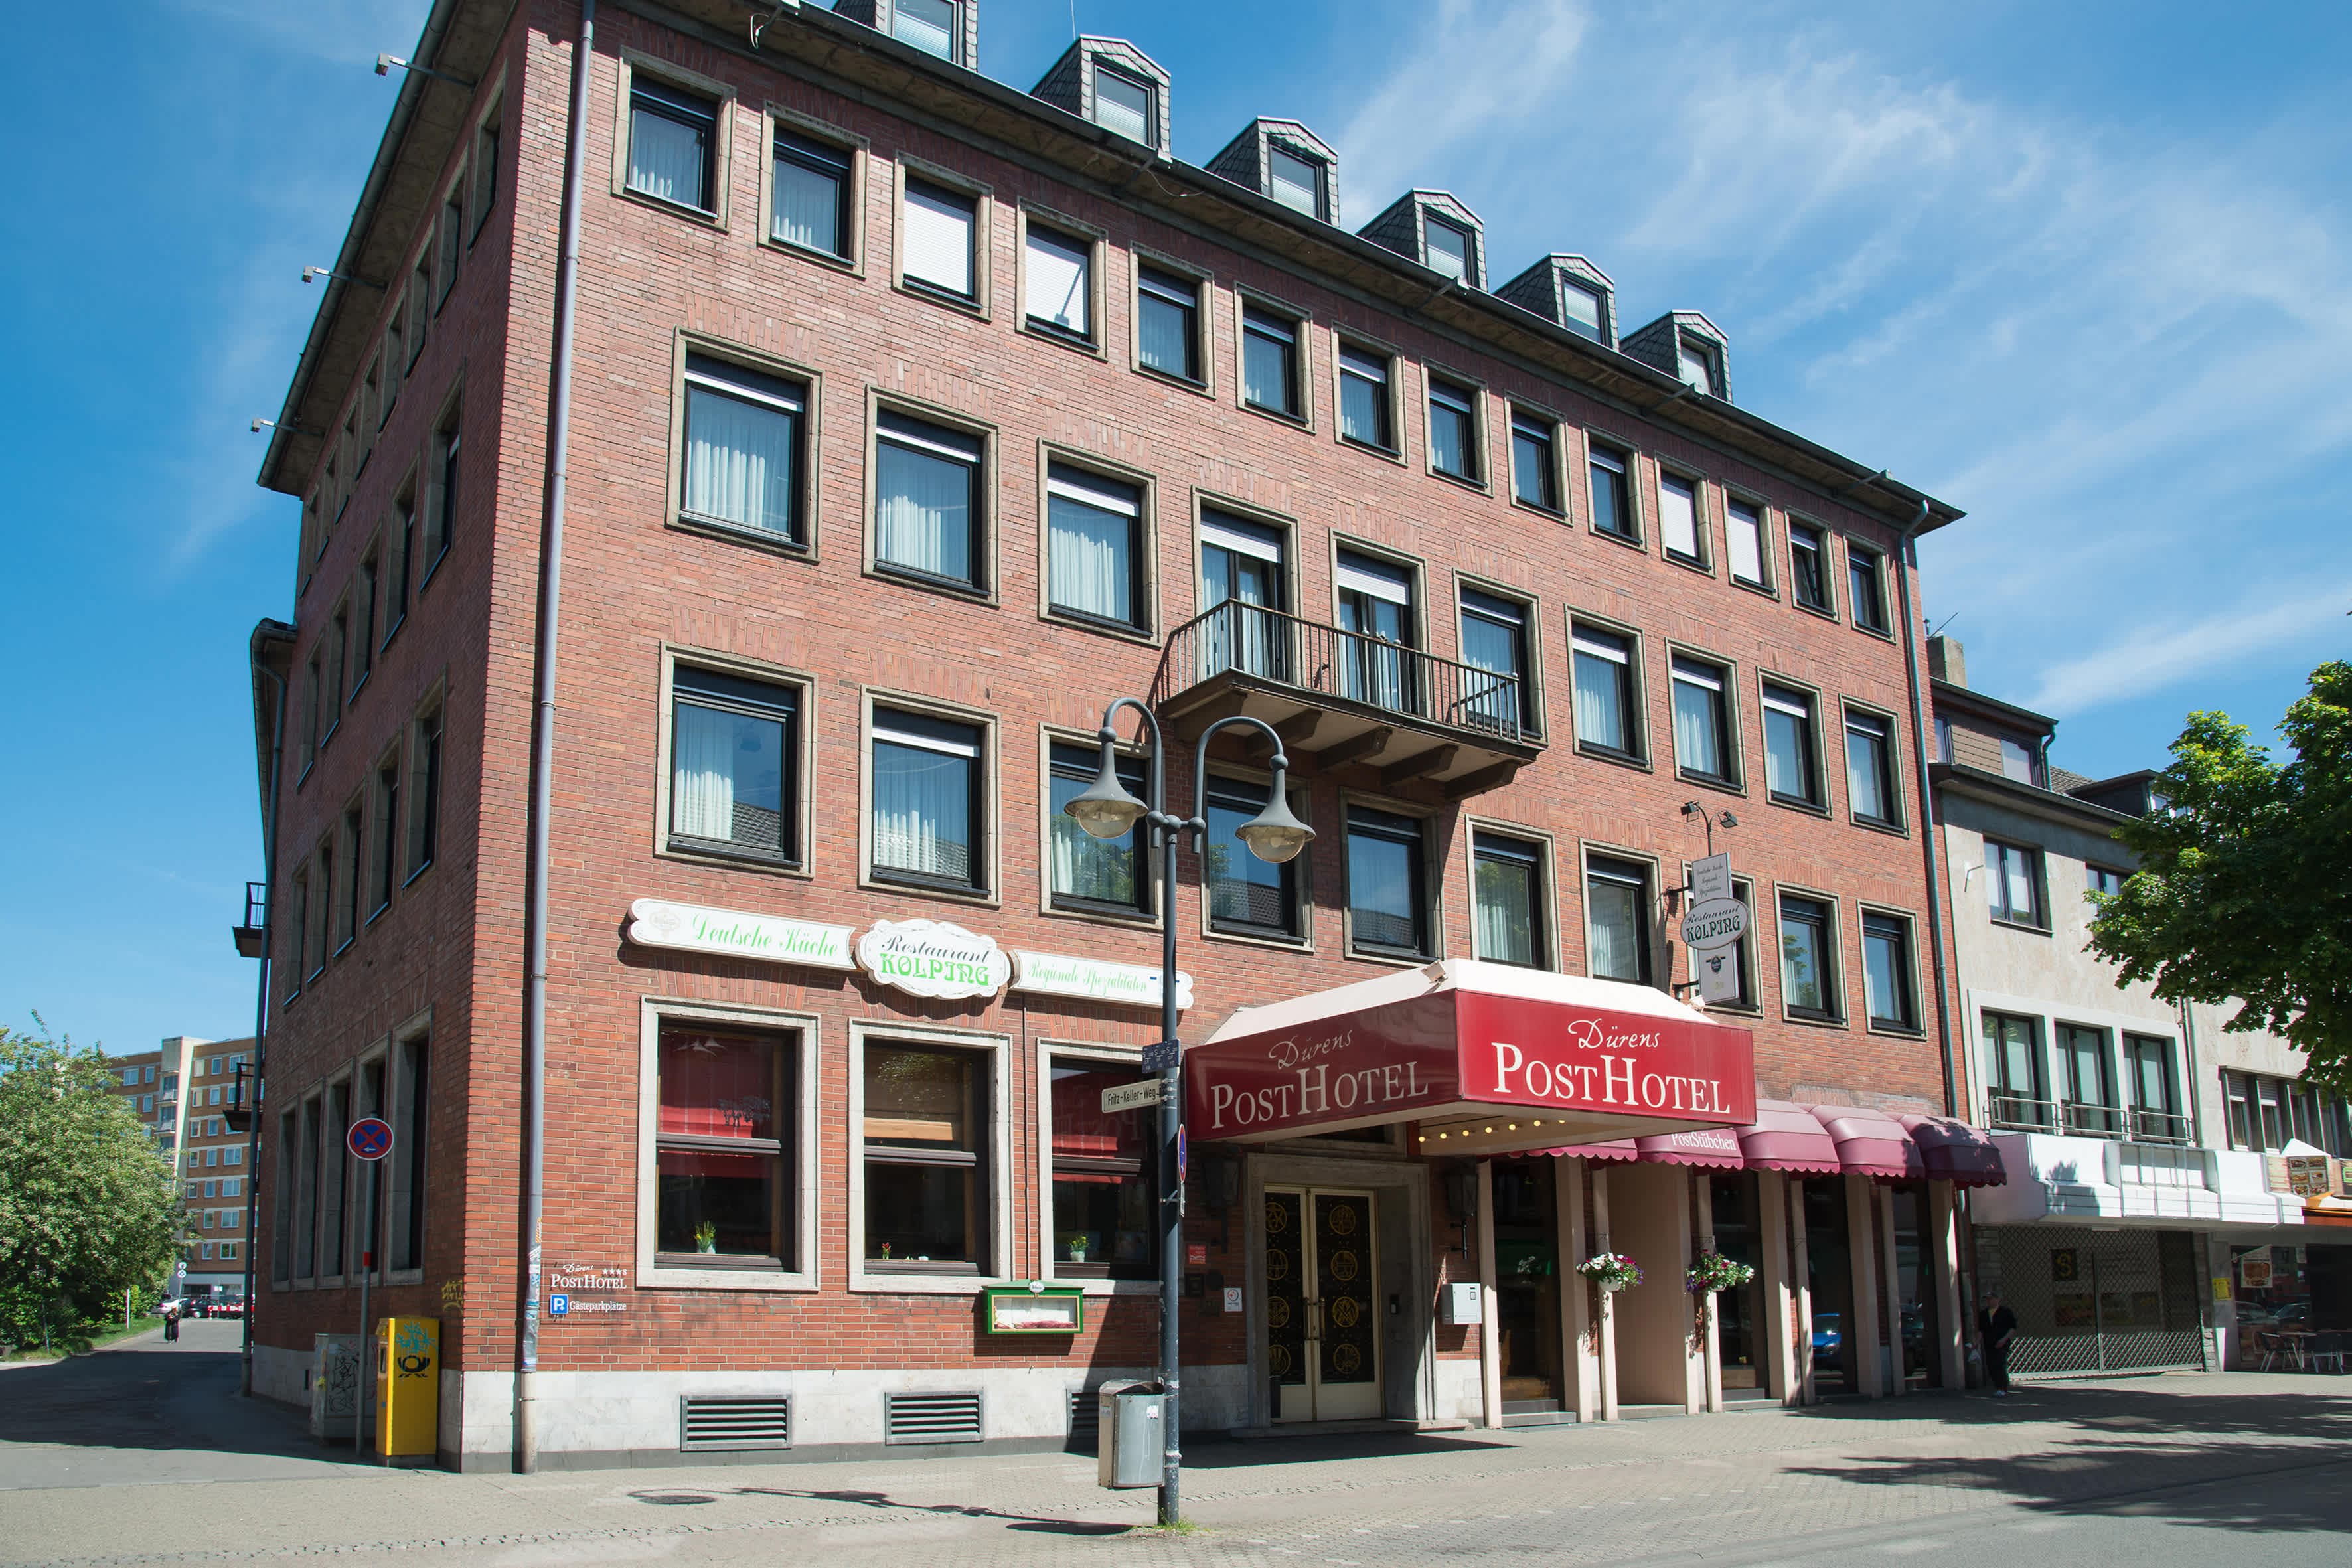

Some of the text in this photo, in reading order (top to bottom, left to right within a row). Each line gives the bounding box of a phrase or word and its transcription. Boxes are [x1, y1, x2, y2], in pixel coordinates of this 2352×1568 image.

[1684, 905, 1740, 924] Restaurant
[1686, 915, 1741, 943] KOLPING
[692, 911, 771, 949] Deutsche
[779, 927, 838, 957] Küche
[881, 934, 990, 963] Restaurant
[880, 953, 989, 986] KOLPING
[1028, 957, 1079, 988] Regionale
[1567, 1018, 1660, 1050] Dürens
[1268, 1030, 1354, 1070] Dürens
[1108, 1087, 1156, 1105] Fritz-Keller-Weg
[1671, 1131, 1737, 1150] PostStübchen
[569, 1300, 627, 1312] Gästeparkplätze
